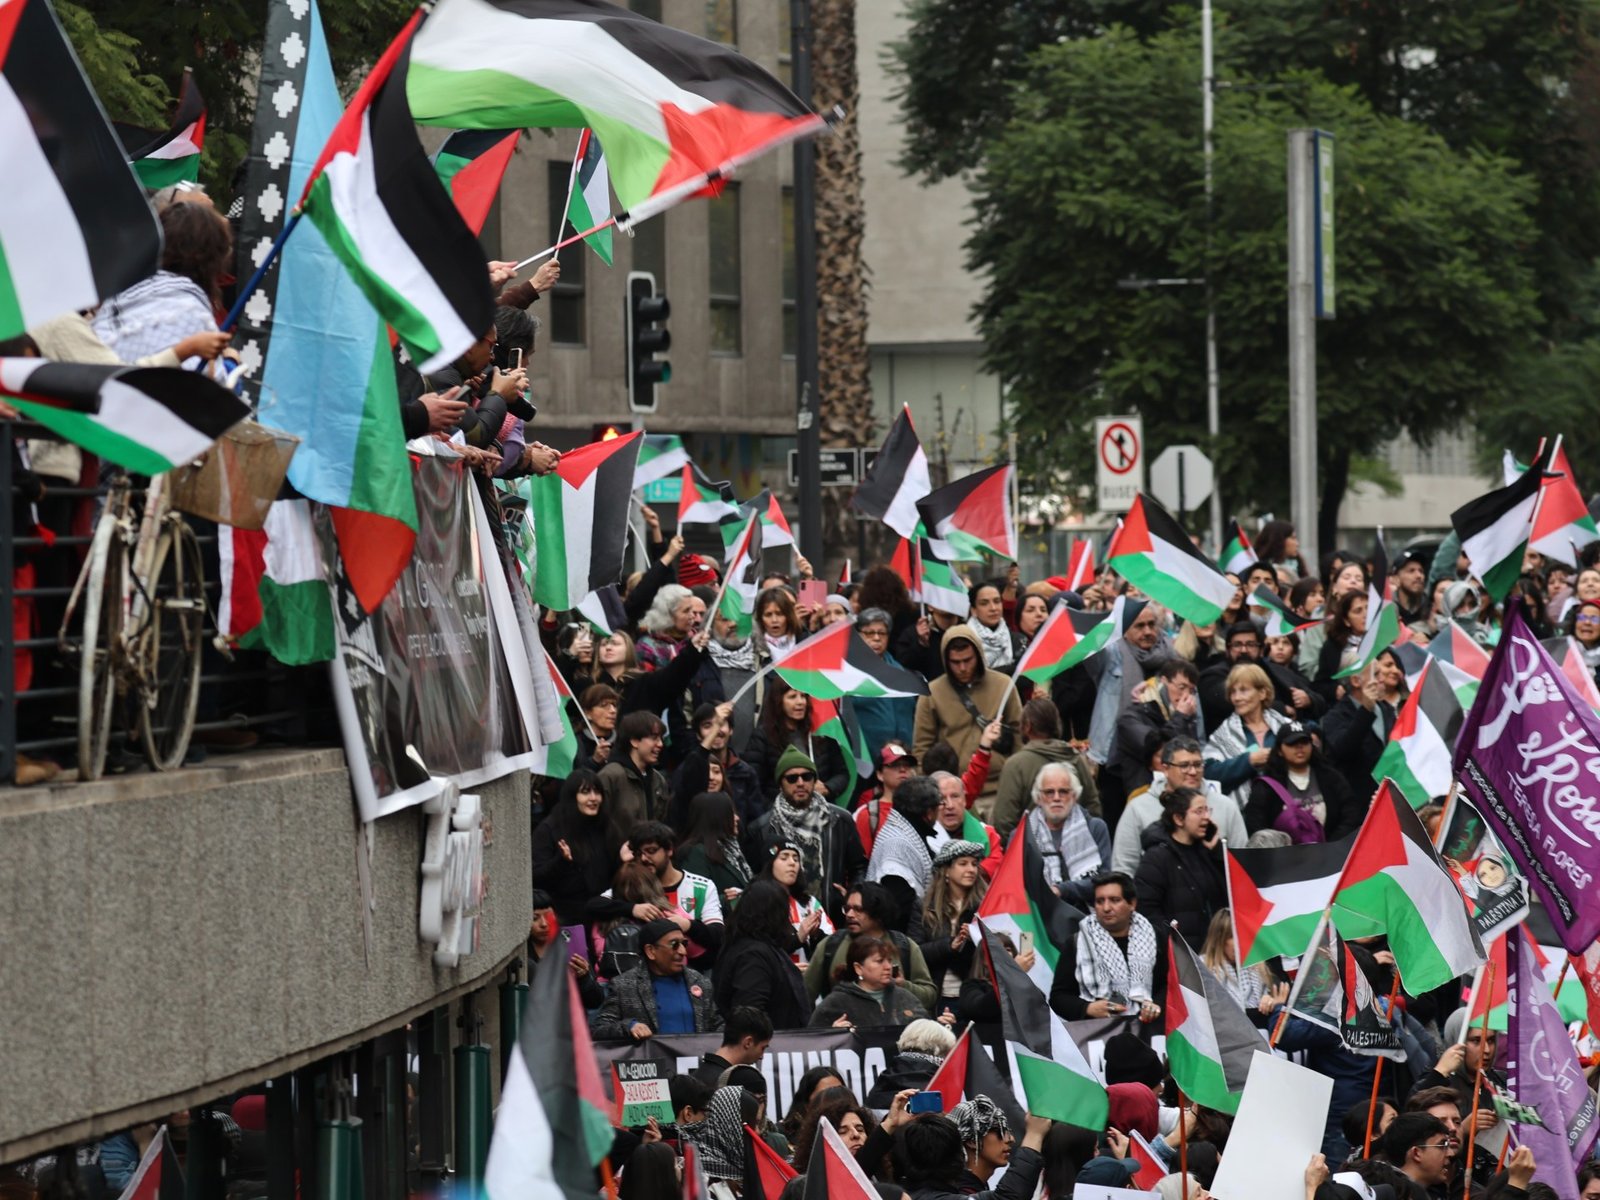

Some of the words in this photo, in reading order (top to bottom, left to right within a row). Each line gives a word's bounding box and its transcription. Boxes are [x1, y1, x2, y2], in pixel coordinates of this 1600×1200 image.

[1507, 770, 1541, 840] TERESA
[1542, 834, 1593, 890] FLORES
[1478, 896, 1518, 930] PALESTINA
[1346, 1029, 1388, 1046] PALESTINA
